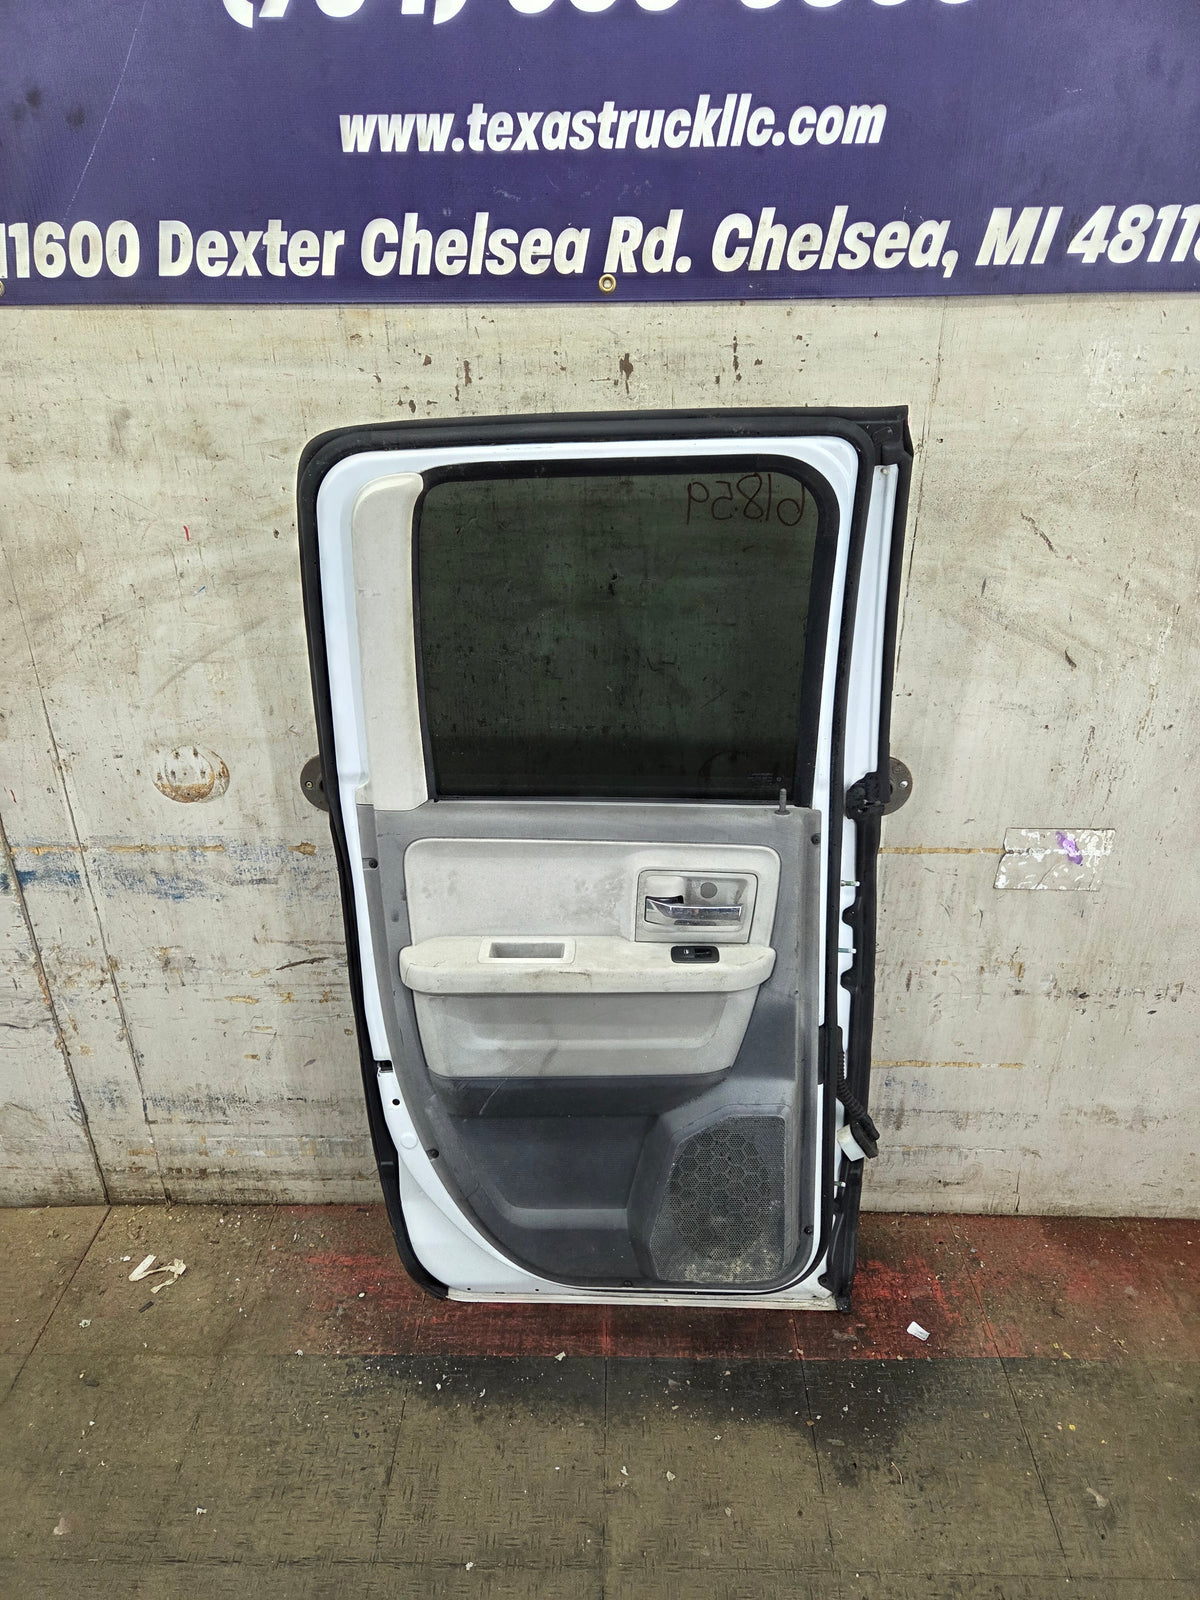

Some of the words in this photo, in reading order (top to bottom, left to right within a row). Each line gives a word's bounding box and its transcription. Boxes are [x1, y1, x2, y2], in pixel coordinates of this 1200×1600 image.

[339, 92, 887, 153] www.texastruckllc.com
[158, 218, 346, 278] Dexter
[360, 211, 591, 278] Chelsea
[603, 208, 692, 274] Rd.
[711, 204, 959, 279] Chelsea,
[974, 205, 1064, 267] MI
[1066, 203, 1200, 264] 4811
